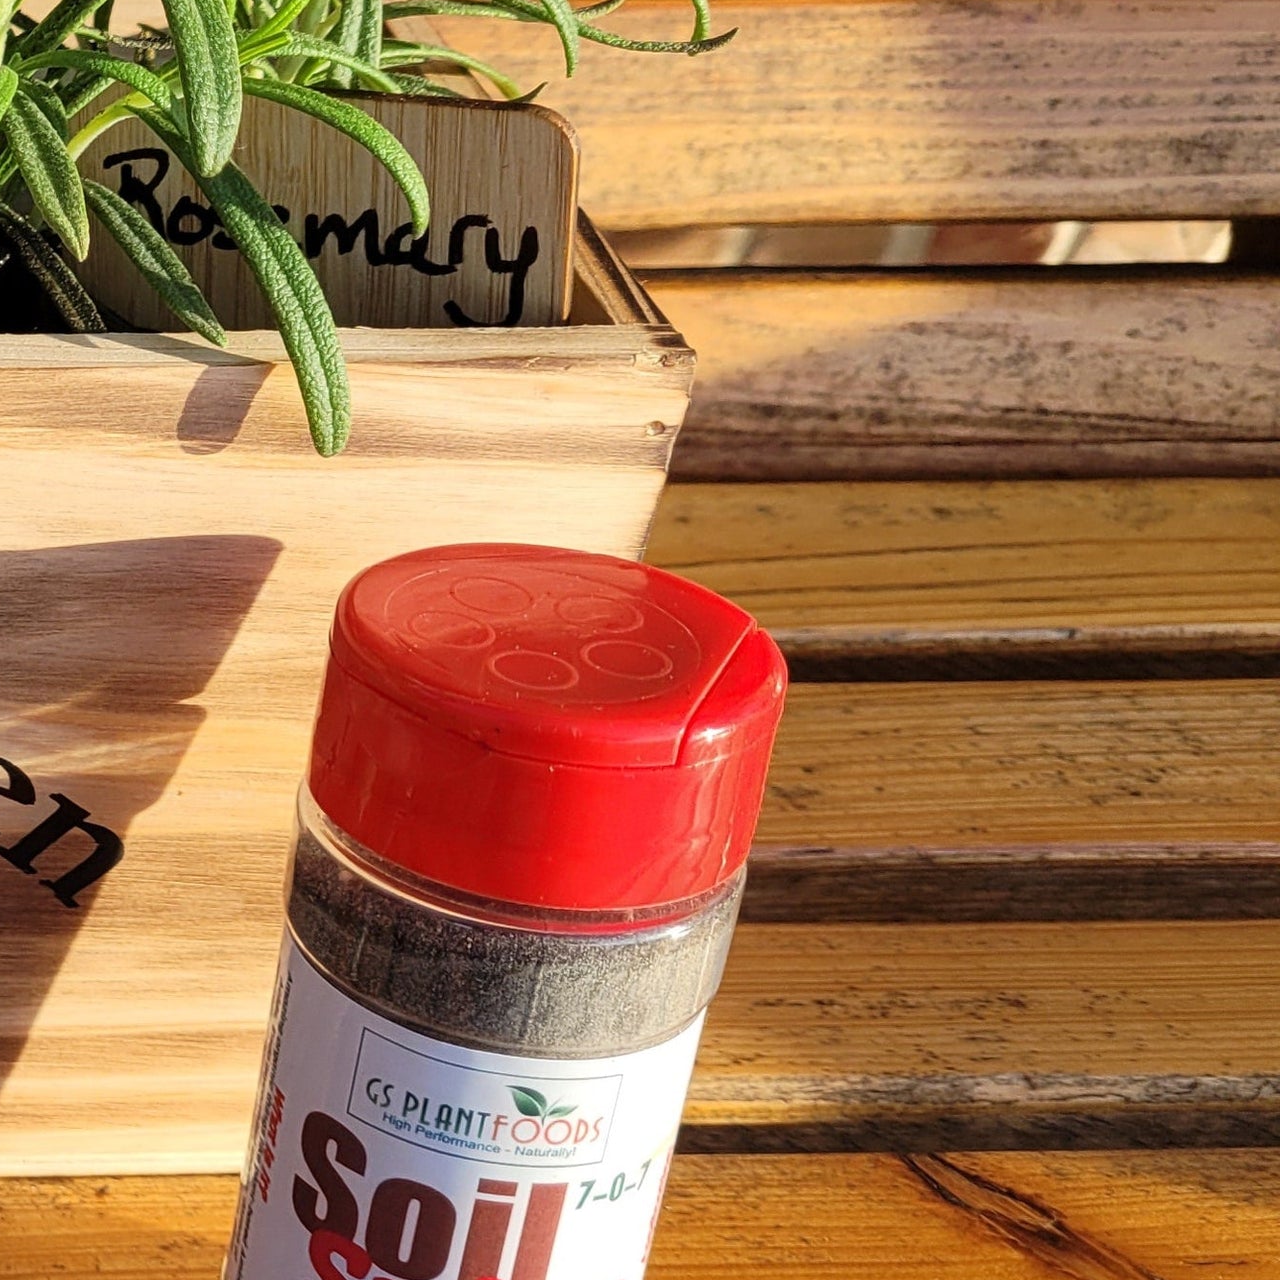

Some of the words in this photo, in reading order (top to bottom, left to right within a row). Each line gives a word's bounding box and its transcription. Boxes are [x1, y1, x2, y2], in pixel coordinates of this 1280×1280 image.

[103, 147, 539, 328] Rosmary
[366, 1078, 395, 1108] GS
[402, 1090, 606, 1146] PLANTFOODS
[382, 1111, 412, 1132] High
[414, 1123, 502, 1154] Performance
[514, 1145, 578, 1159] Naturally!
